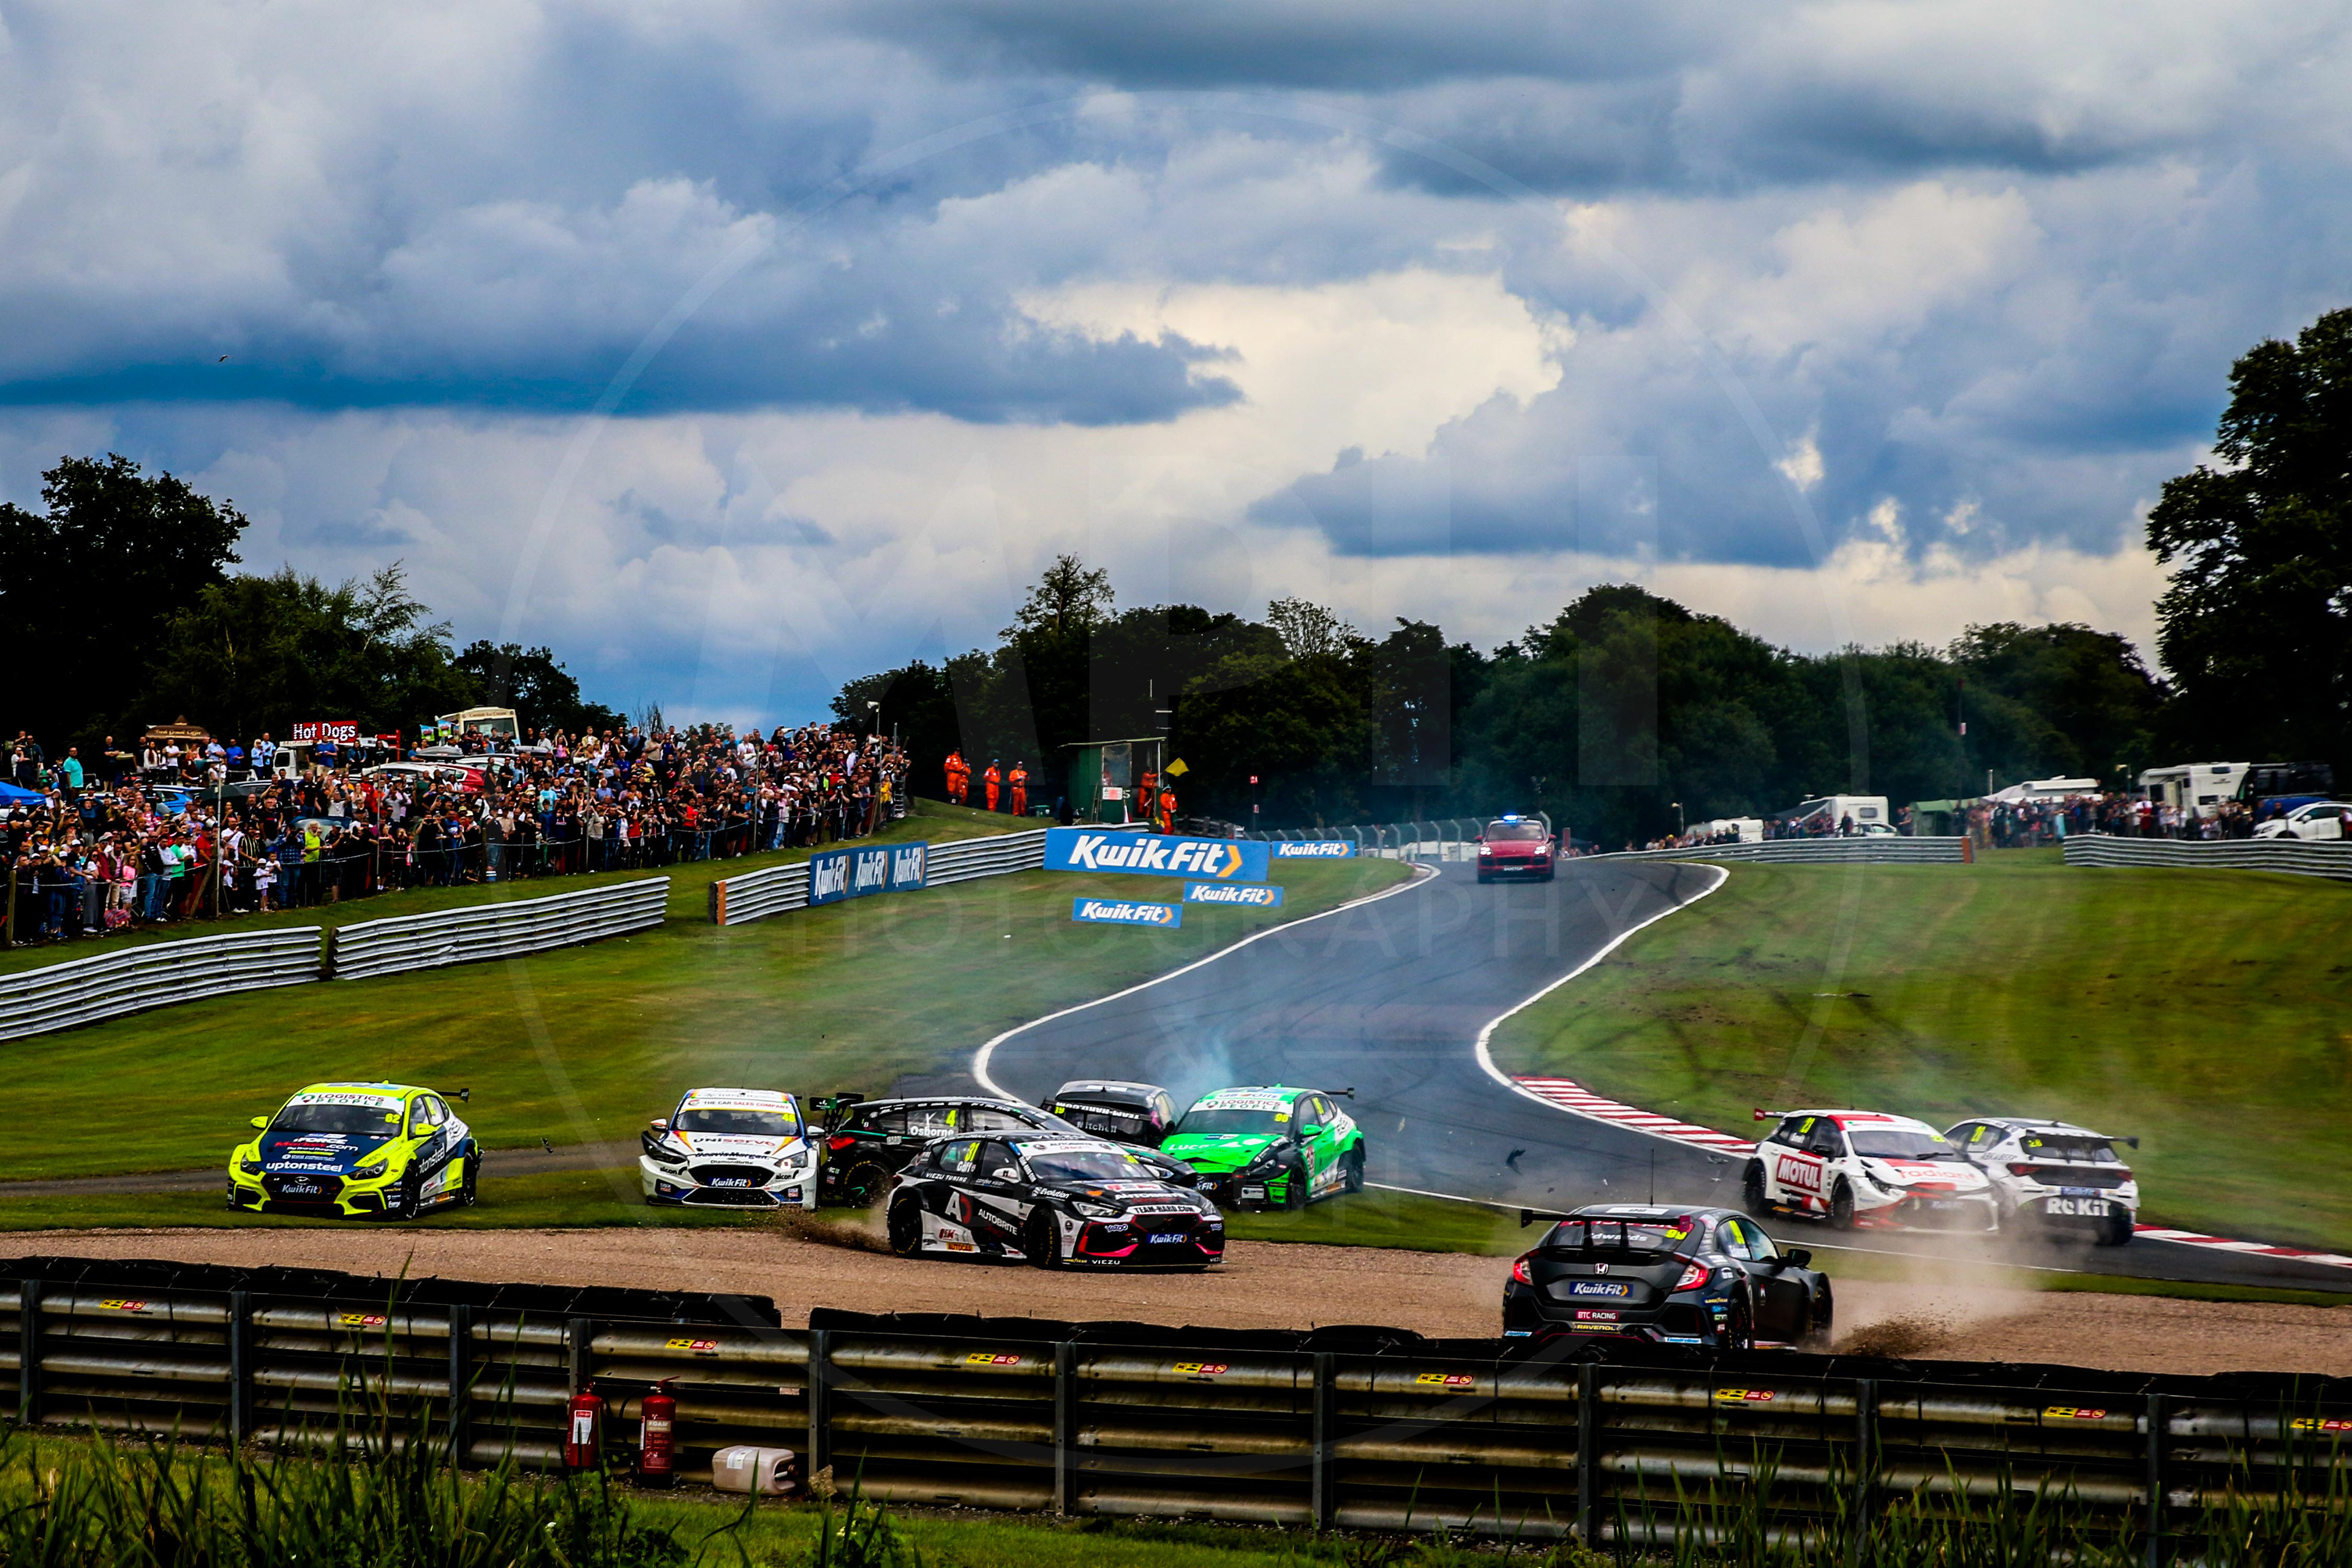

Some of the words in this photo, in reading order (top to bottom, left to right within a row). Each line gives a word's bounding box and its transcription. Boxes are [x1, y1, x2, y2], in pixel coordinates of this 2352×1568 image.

[293, 723, 317, 740] Hot
[322, 723, 356, 741] Dogs
[385, 1113, 401, 1124] 62
[945, 1109, 957, 1128] 4
[910, 1125, 954, 1137] Osborne
[965, 1142, 980, 1162] 31
[266, 1161, 344, 1173] uptonsteel
[945, 1174, 968, 1183] TUNING
[1777, 1158, 1820, 1189] MOTUL
[1040, 1187, 1072, 1199] Evolution
[978, 1208, 1018, 1236] AUTOBRITE
[1578, 1311, 1591, 1320] BTC
[1592, 1311, 1616, 1320] RACING
